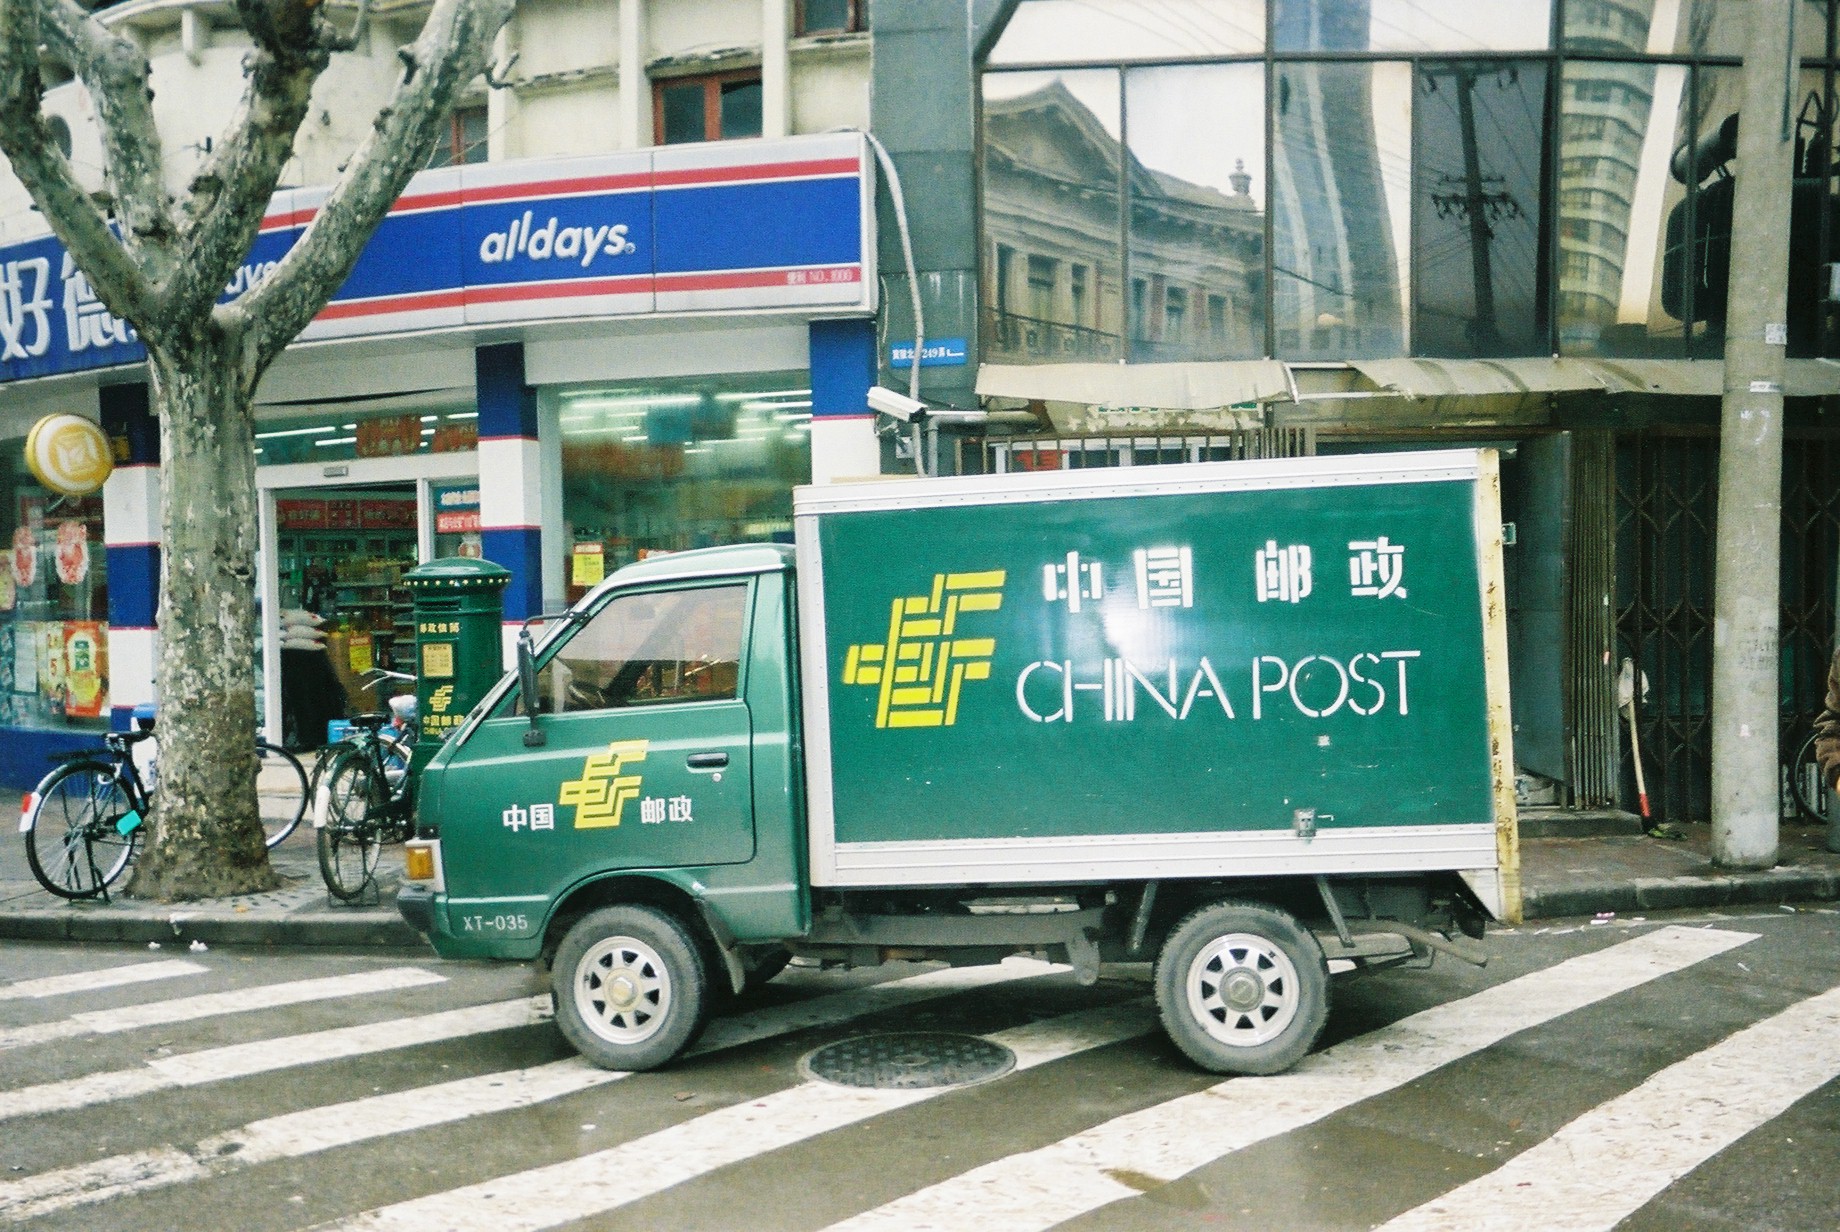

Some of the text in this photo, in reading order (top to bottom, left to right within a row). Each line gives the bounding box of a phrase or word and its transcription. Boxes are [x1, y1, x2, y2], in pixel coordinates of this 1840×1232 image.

[480, 210, 629, 267] alldays
[1016, 649, 1421, 722] CHINA POST
[502, 795, 694, 832] 中国 邮政
[463, 914, 529, 932] XT-035
